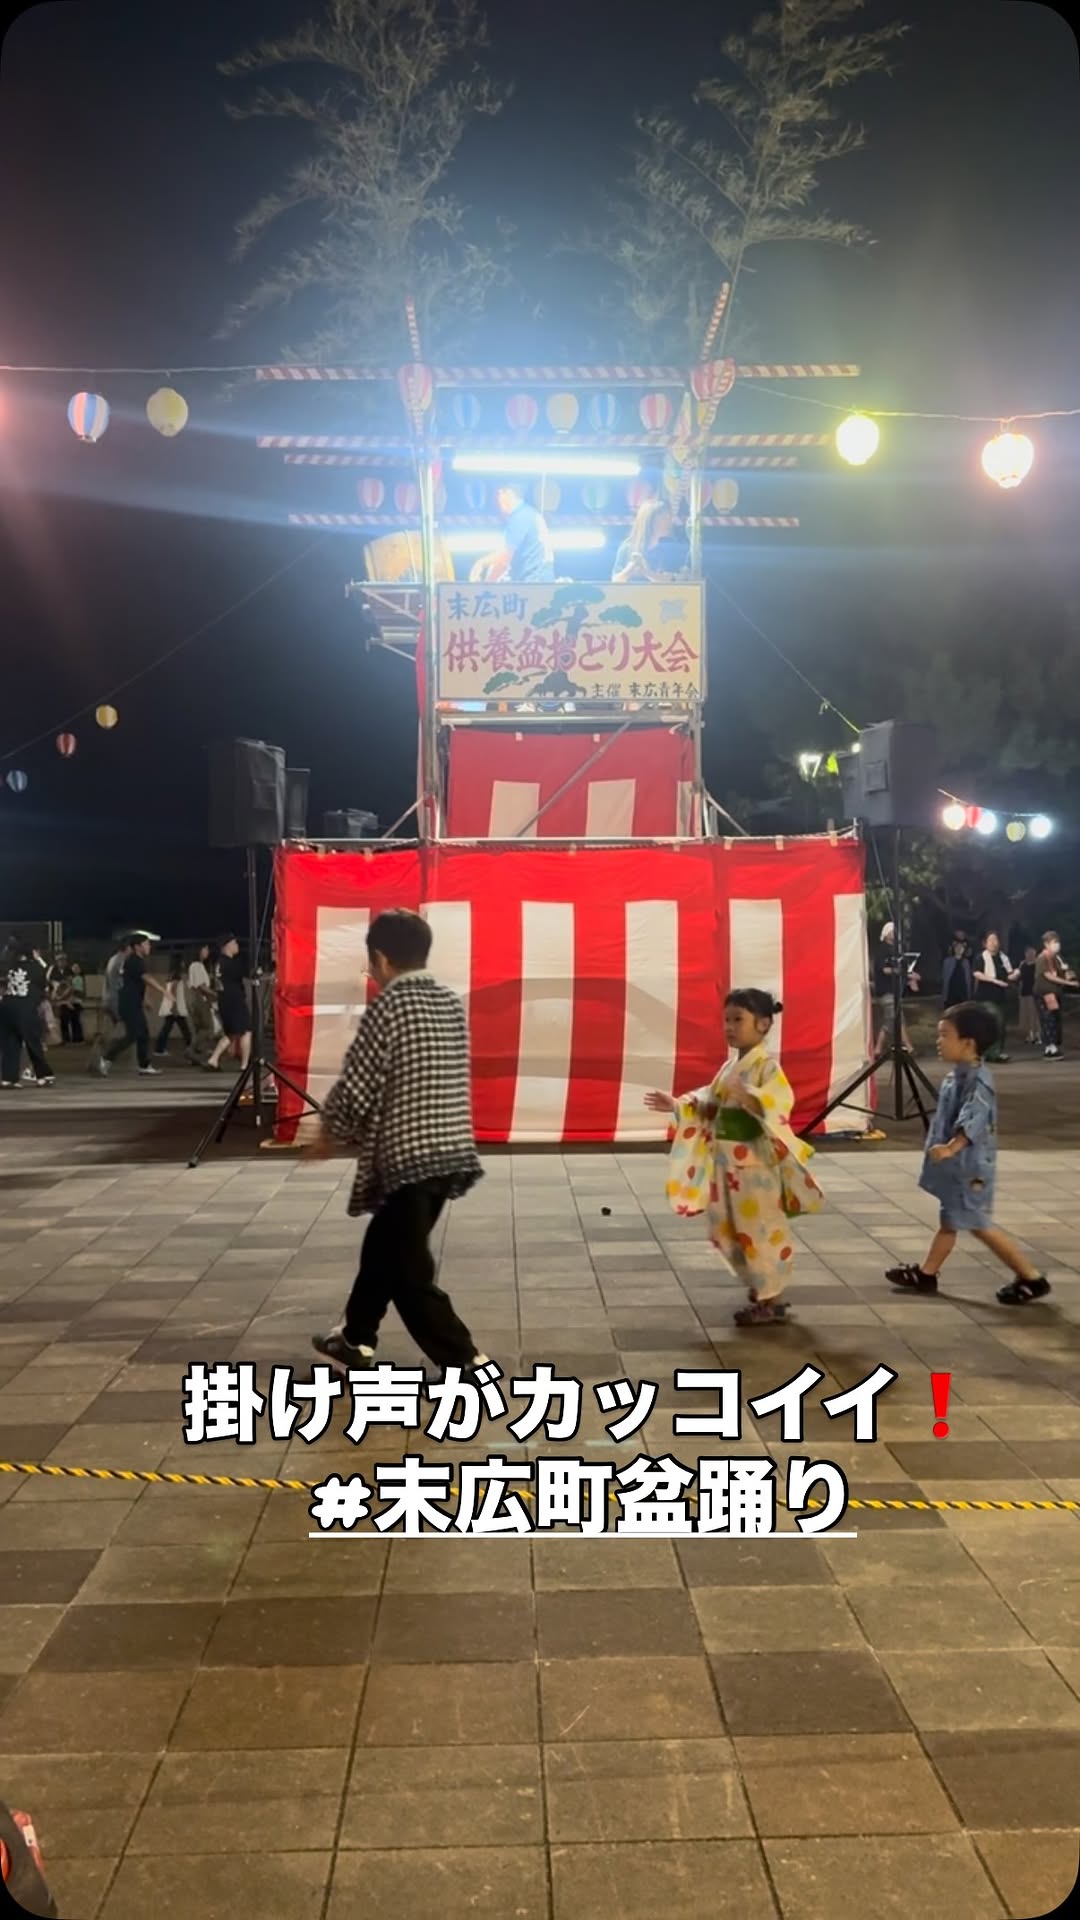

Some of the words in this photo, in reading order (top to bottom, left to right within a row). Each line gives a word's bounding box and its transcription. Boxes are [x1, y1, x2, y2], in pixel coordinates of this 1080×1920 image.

[447, 591, 528, 621] 末広町
[443, 627, 699, 673] 供養盆おどり大会
[592, 683, 622, 698] 主催
